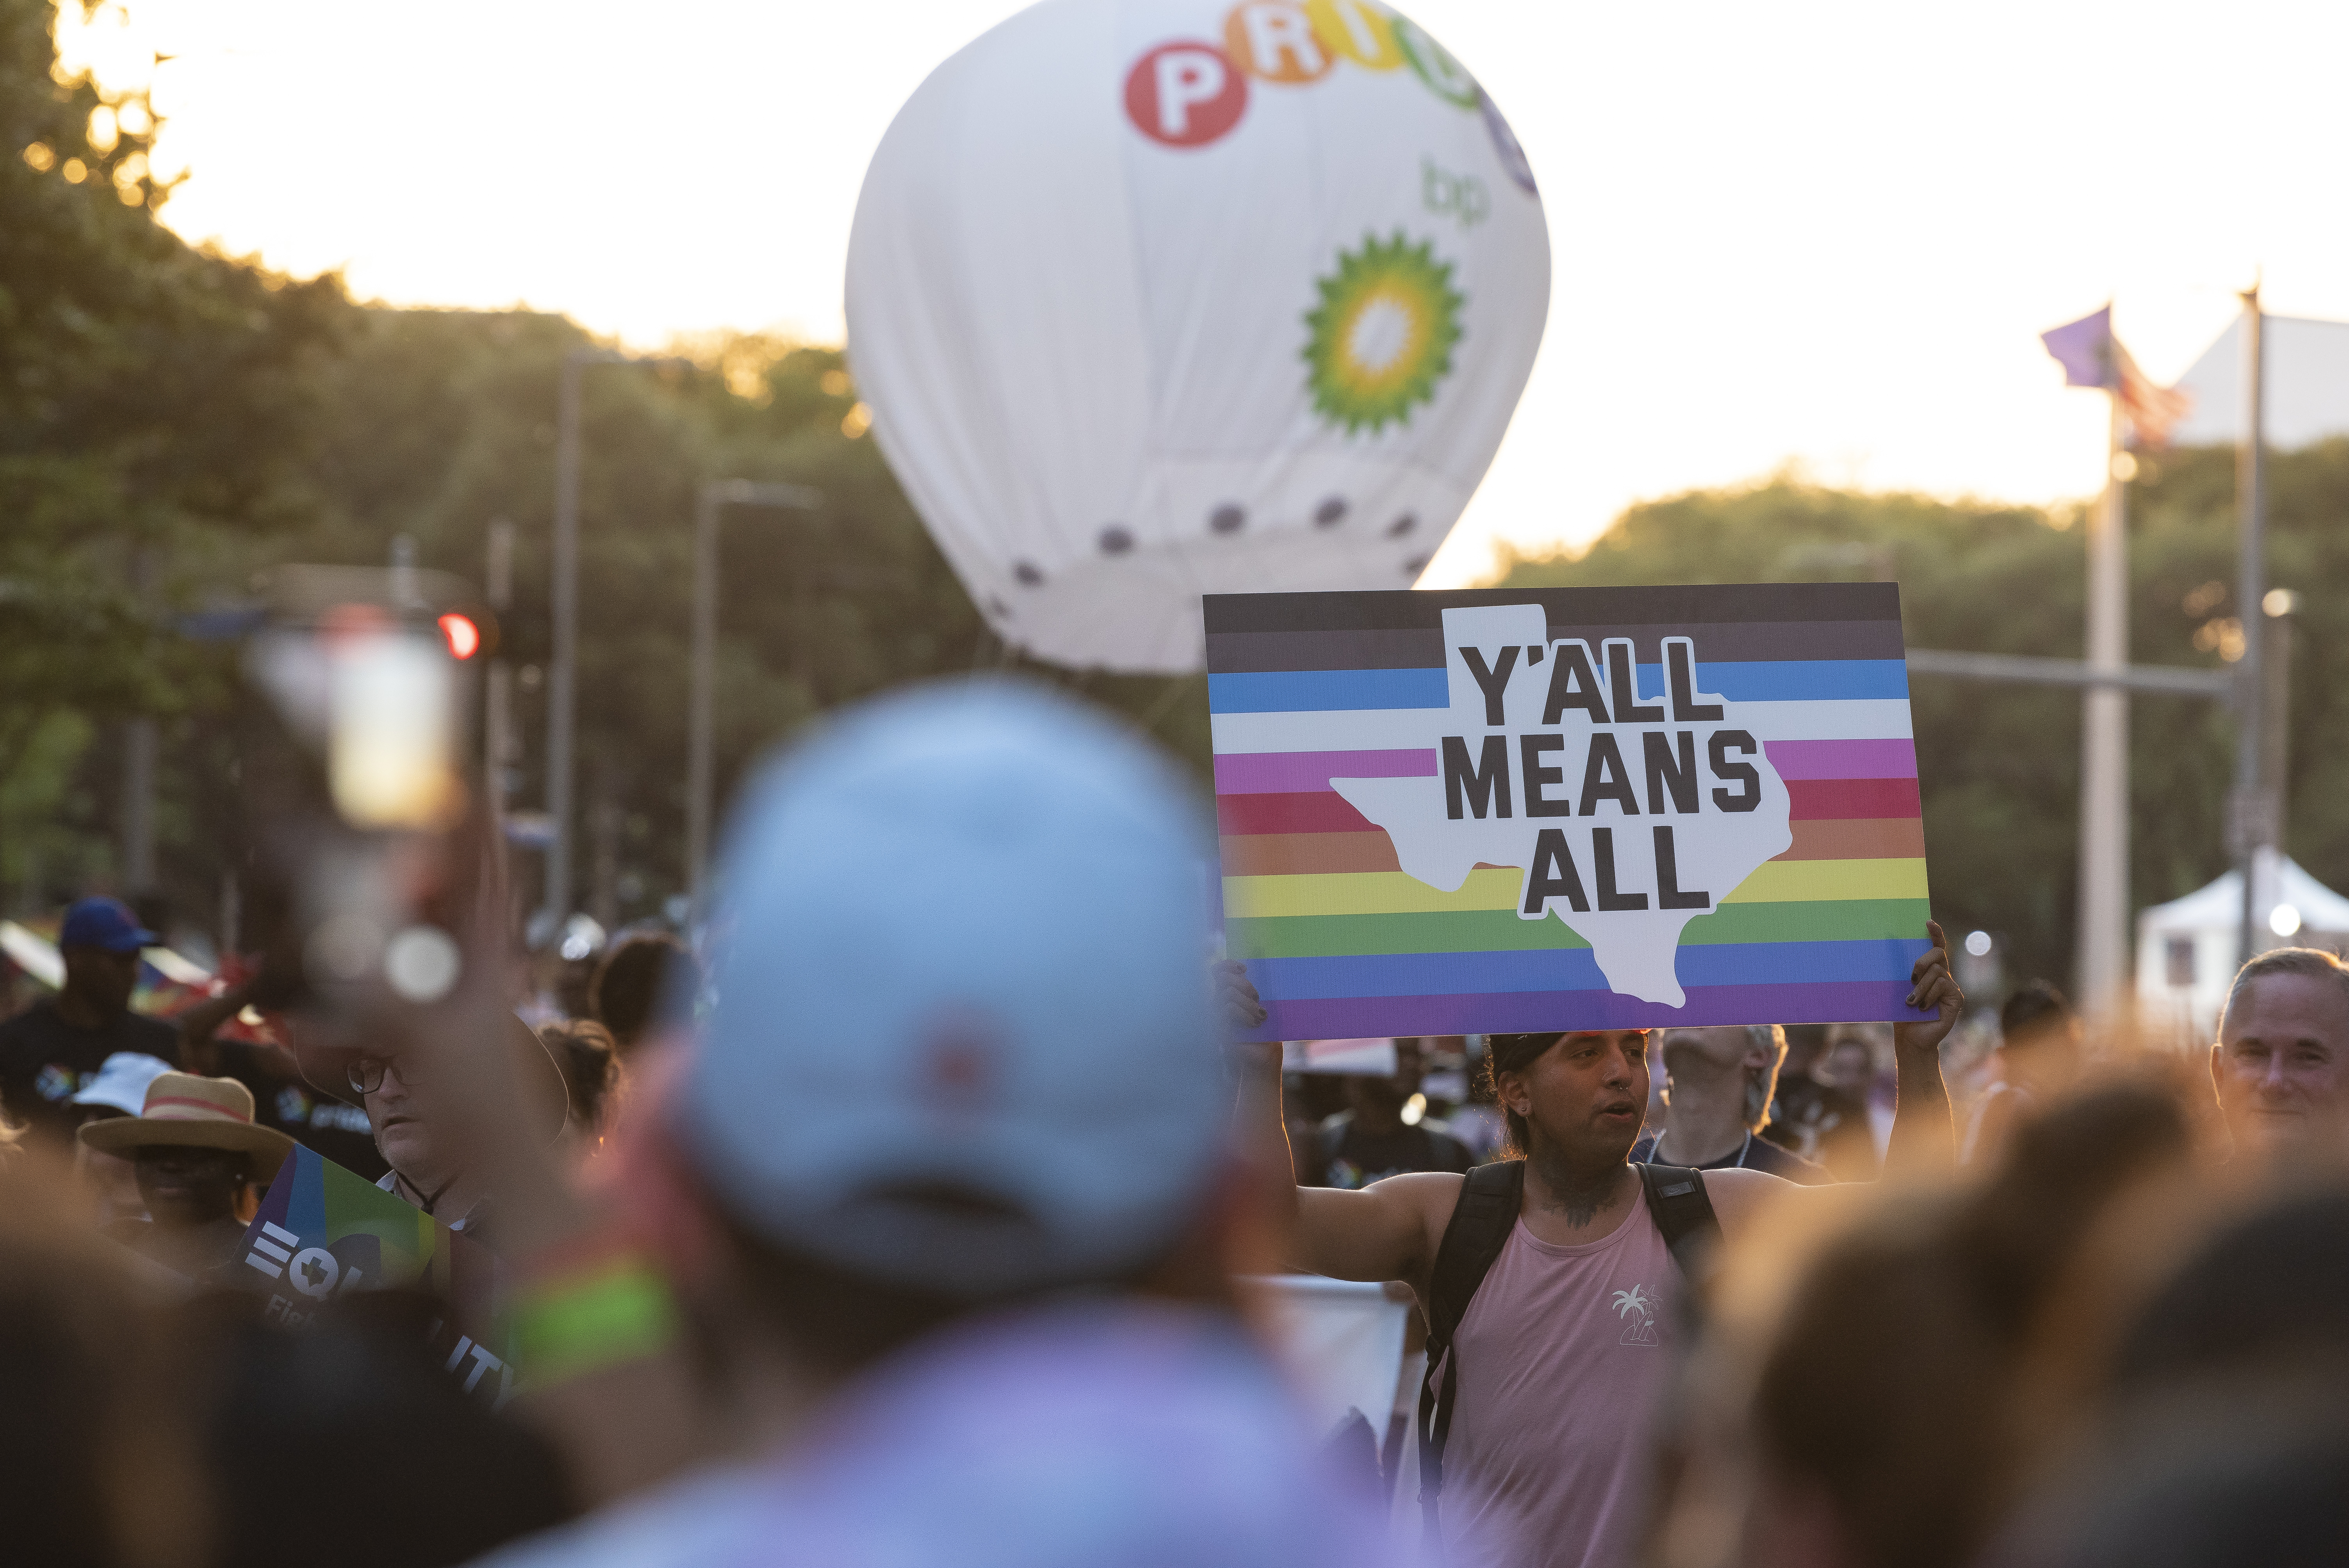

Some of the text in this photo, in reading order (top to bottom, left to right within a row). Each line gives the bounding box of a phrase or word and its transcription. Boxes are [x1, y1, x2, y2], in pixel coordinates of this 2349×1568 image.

[1418, 151, 1493, 230] bp
[1459, 642, 1724, 726] Y'ALL
[1442, 730, 1761, 820] MEANS
[1524, 826, 1710, 913] ALL
